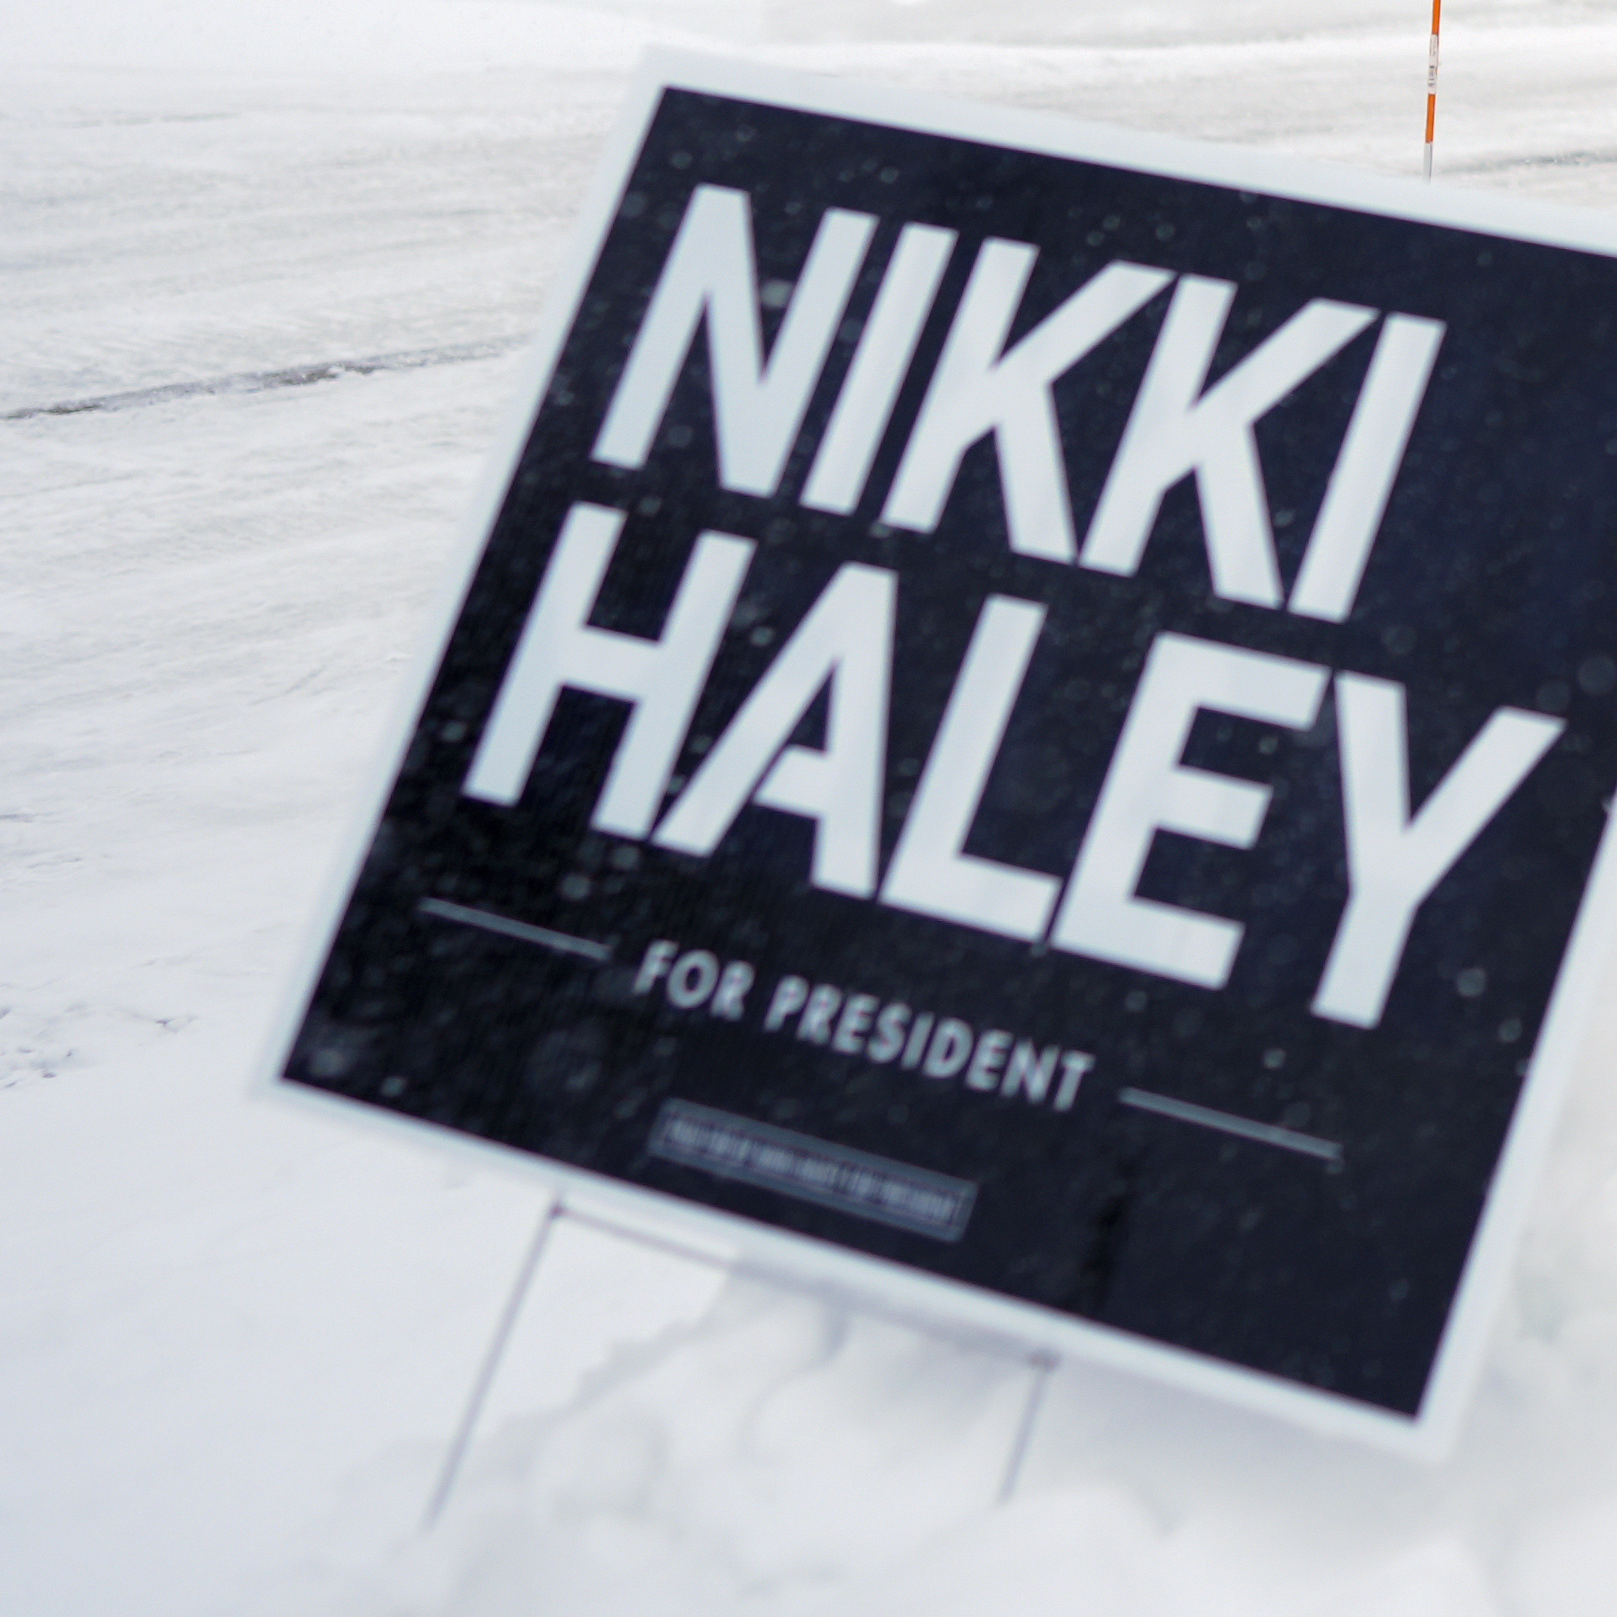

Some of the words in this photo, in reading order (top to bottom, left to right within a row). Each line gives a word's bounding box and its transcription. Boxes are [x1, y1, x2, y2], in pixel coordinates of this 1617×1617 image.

[592, 183, 1446, 623] NIKKI
[463, 502, 1564, 1029] HALEY
[632, 939, 756, 1021] FOR
[763, 975, 1096, 1112] PRESIDENT
